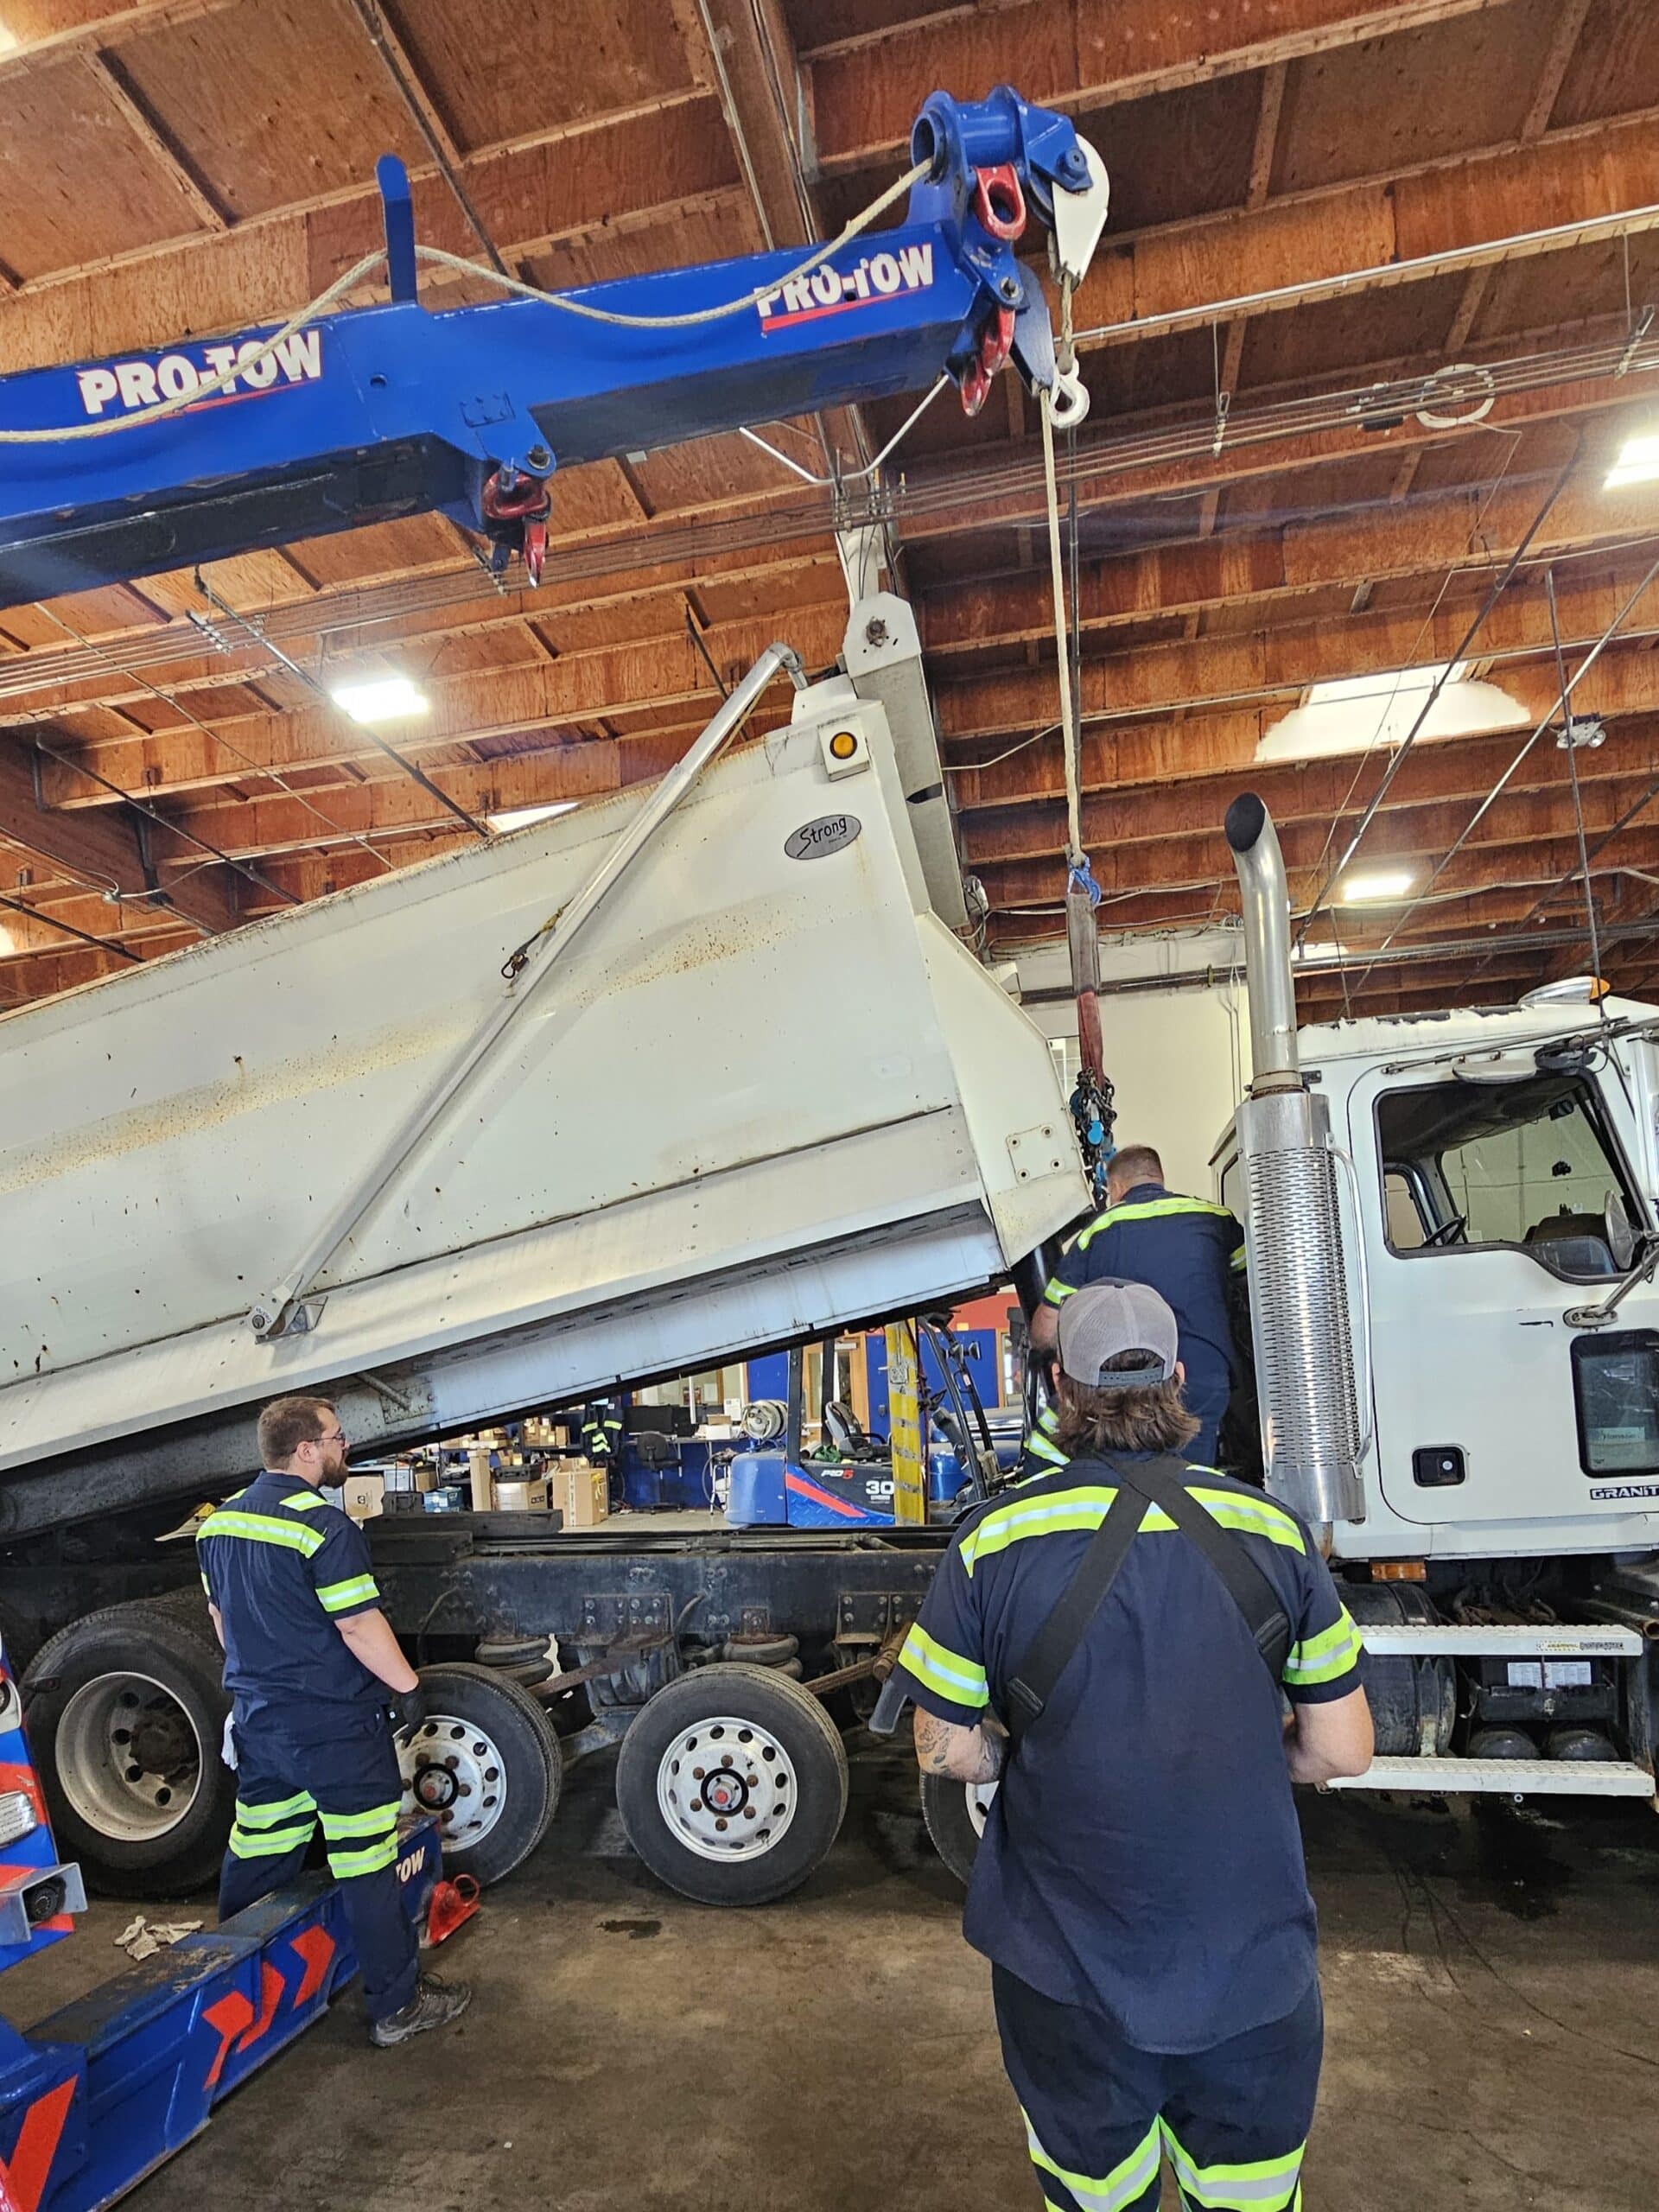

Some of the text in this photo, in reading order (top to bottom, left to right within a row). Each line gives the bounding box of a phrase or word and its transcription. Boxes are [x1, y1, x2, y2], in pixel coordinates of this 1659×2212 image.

[76, 331, 321, 414] PRO-TOW
[797, 817, 847, 857] Strong
[866, 1480, 894, 1495] 30
